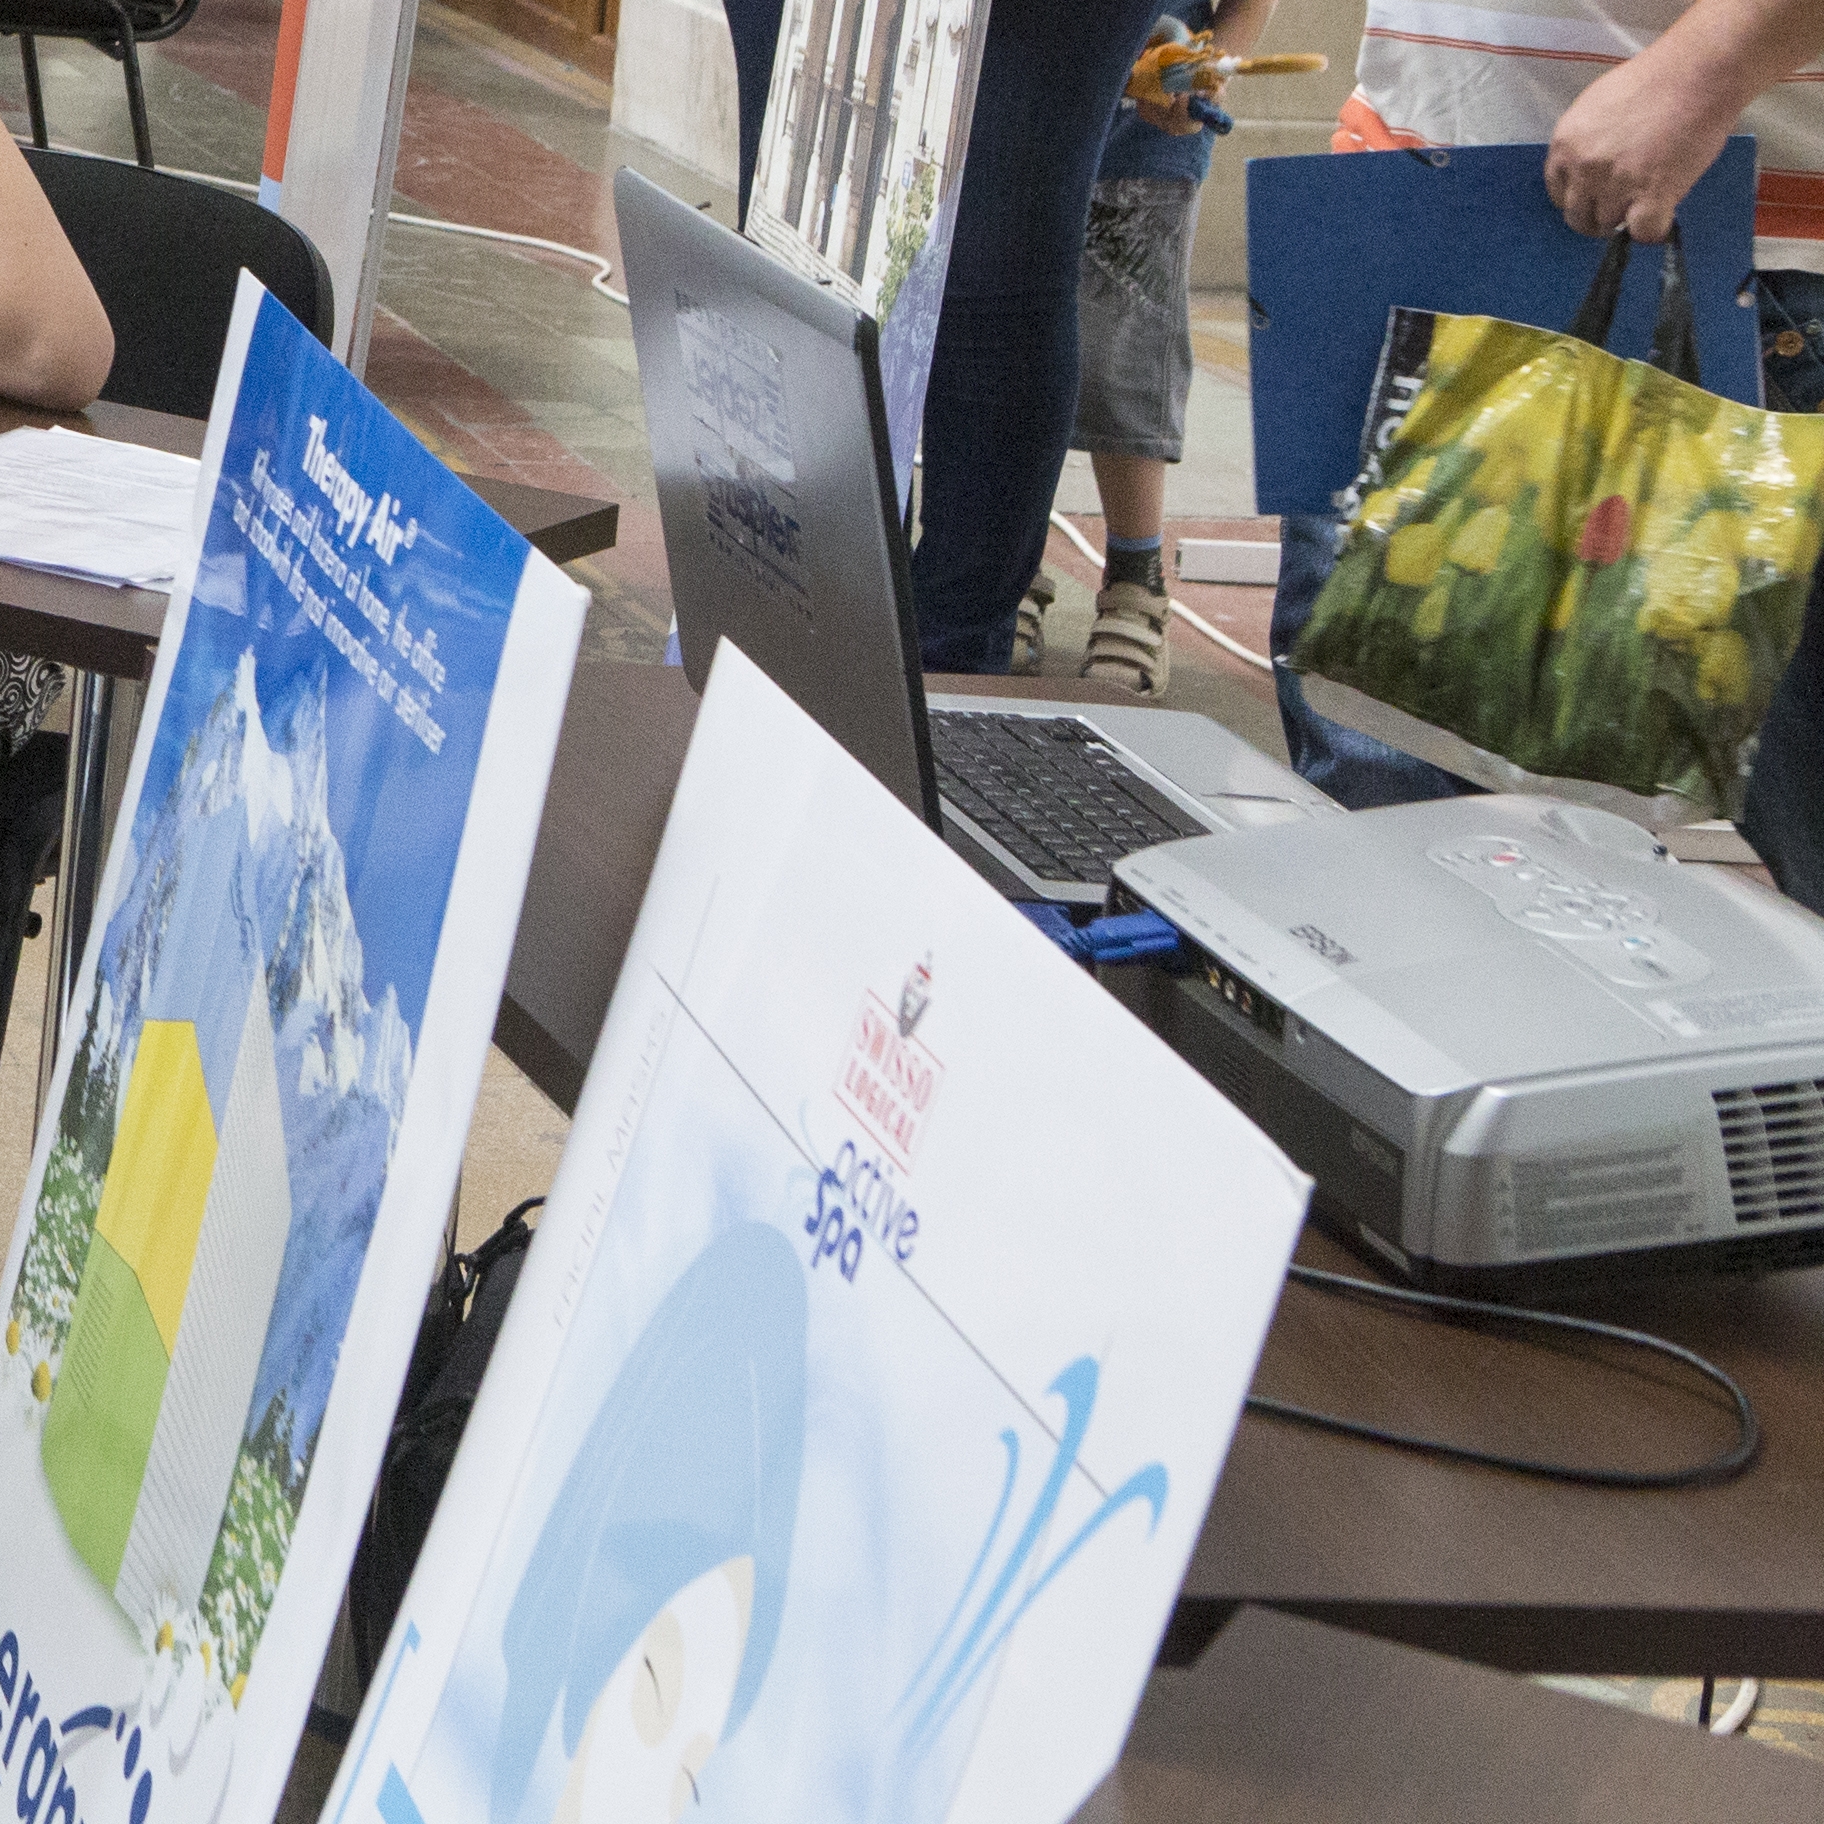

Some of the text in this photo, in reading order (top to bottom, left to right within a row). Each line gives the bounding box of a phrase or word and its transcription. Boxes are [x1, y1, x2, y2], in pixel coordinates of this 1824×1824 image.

[302, 413, 373, 550] Therapy
[262, 466, 295, 526] viruses
[290, 505, 320, 548] and
[345, 569, 363, 603] at
[391, 603, 413, 660] the
[410, 627, 446, 695] office
[288, 550, 307, 604] the
[302, 585, 329, 630] most
[377, 662, 398, 704] air
[1288, 924, 1357, 966] EPSON
[843, 1056, 917, 1157] LOGICAL
[854, 1007, 936, 1115] SWISSO
[833, 1138, 921, 1262] active
